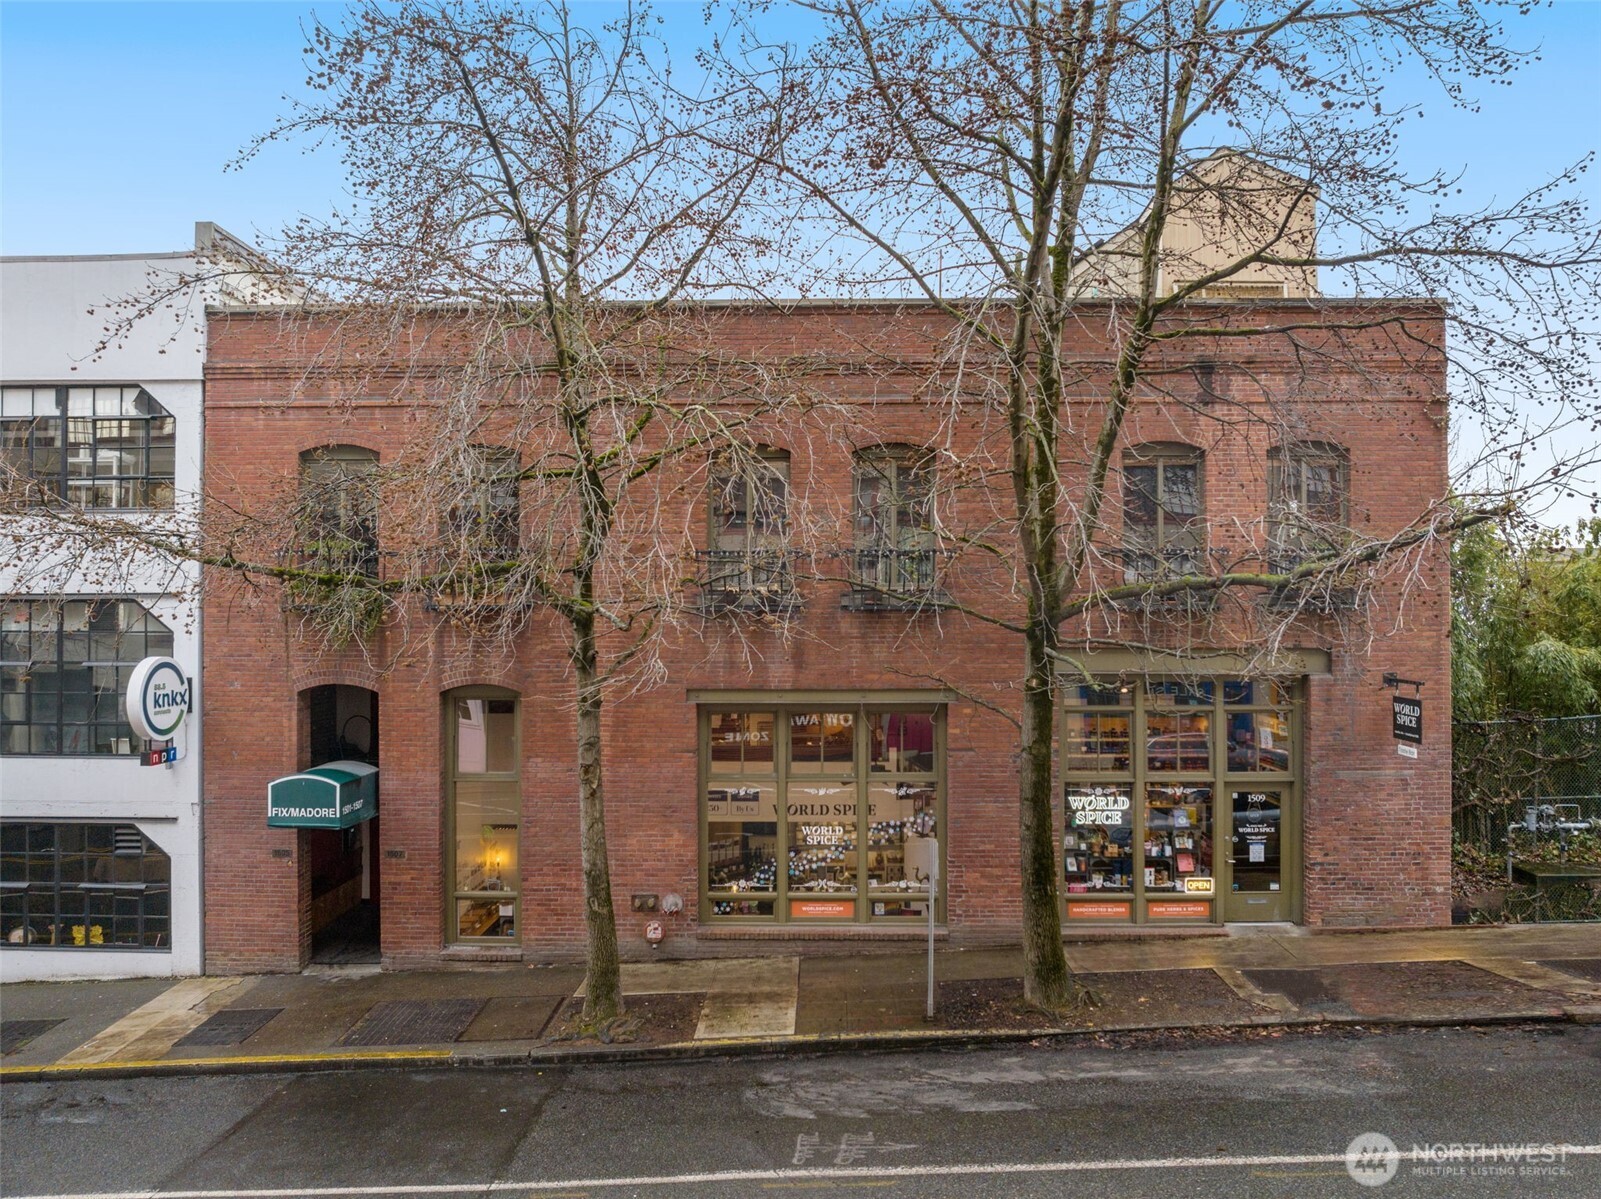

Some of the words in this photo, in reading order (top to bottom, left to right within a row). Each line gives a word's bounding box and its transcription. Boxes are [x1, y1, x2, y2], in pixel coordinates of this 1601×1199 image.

[153, 689, 188, 709] knkx
[1396, 714, 1416, 727] SPICE
[152, 751, 176, 763] npr
[1247, 794, 1266, 803] 1509
[272, 807, 336, 818] FIX/MADORE
[342, 799, 364, 816] 1501-1507
[833, 804, 877, 816] SPIE
[1075, 810, 1122, 825] SPICE
[806, 835, 839, 845] SPICE
[1187, 881, 1211, 890] OPEN
